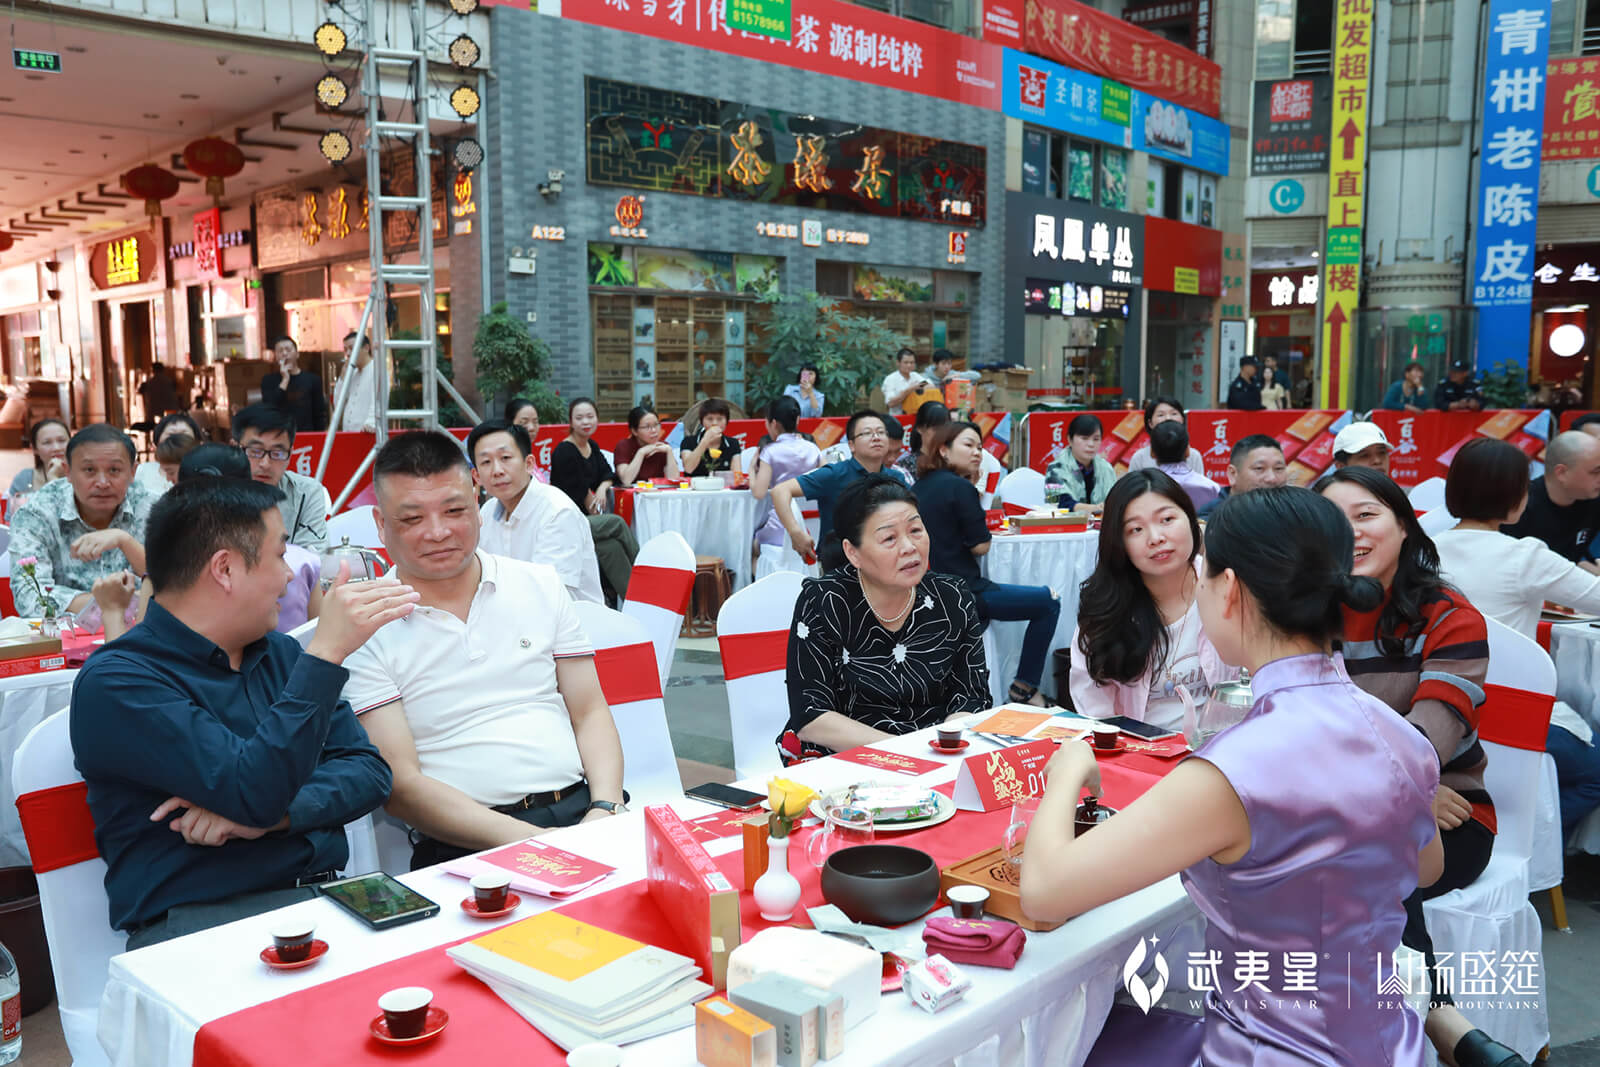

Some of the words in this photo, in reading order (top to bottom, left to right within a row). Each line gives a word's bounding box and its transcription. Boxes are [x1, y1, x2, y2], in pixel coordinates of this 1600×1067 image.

[829, 22, 924, 79] 源制纯粹
[1480, 8, 1548, 284] 青柑老陈皮
[531, 224, 566, 241] A122
